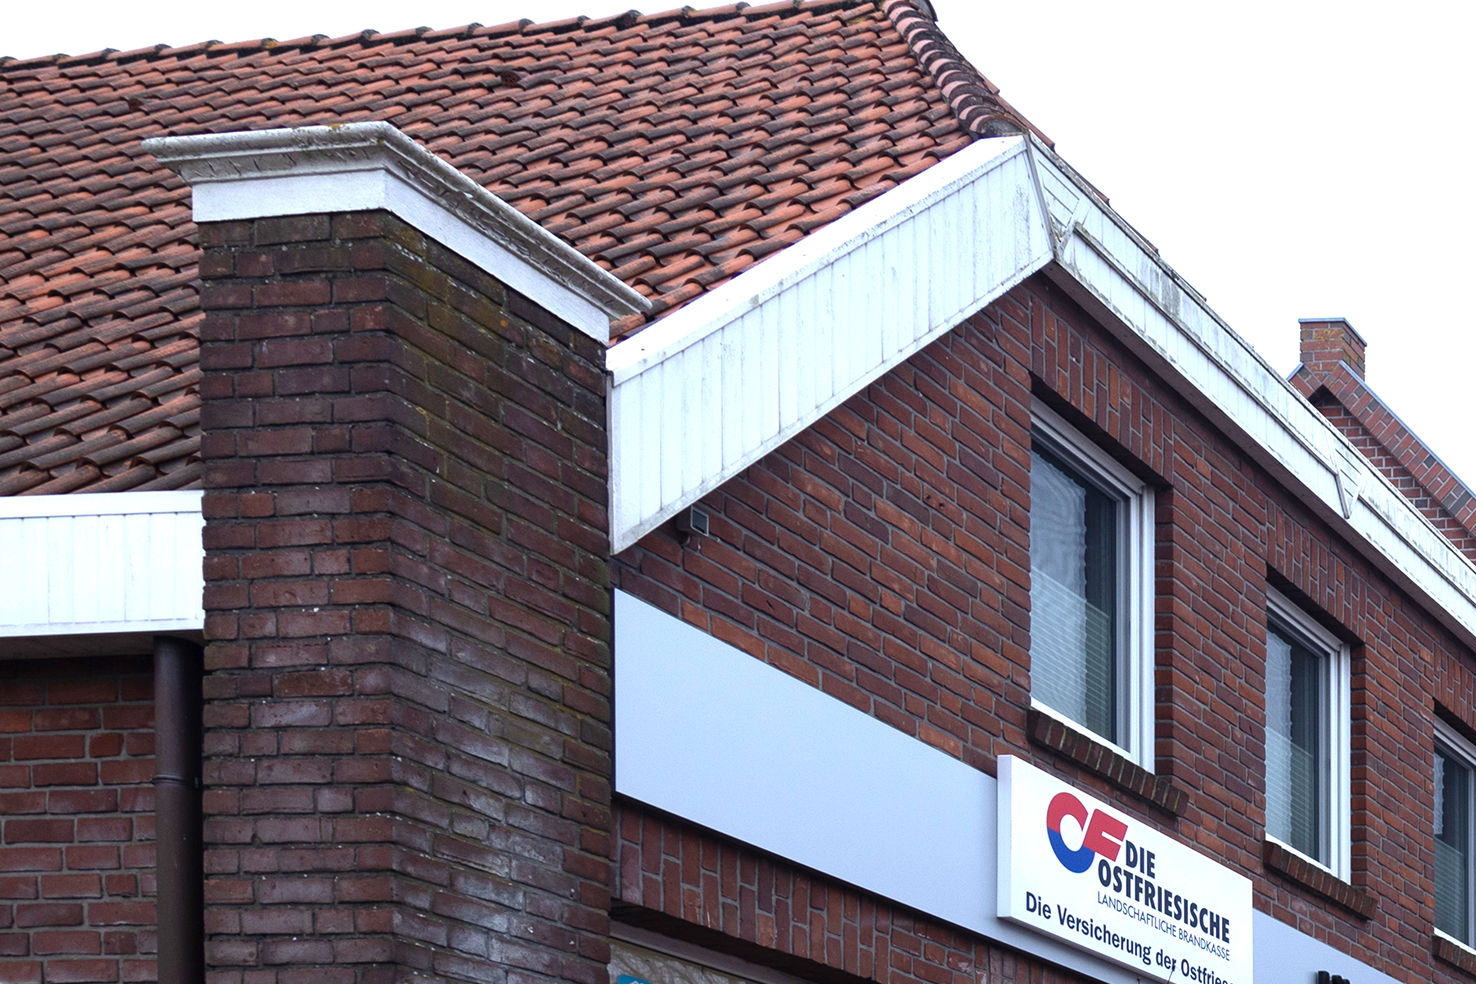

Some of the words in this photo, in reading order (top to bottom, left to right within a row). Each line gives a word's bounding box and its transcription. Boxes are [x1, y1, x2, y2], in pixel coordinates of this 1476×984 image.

[1125, 839, 1155, 879] DIE
[1026, 891, 1051, 920] Die
[1057, 904, 1151, 965] Versicherung
[1156, 948, 1176, 971] der
[1097, 891, 1176, 937] LANDSCHAFTLICHE
[1178, 929, 1230, 961] BRANDKASSE
[1098, 859, 1229, 943] OSTFRIESISCHE
